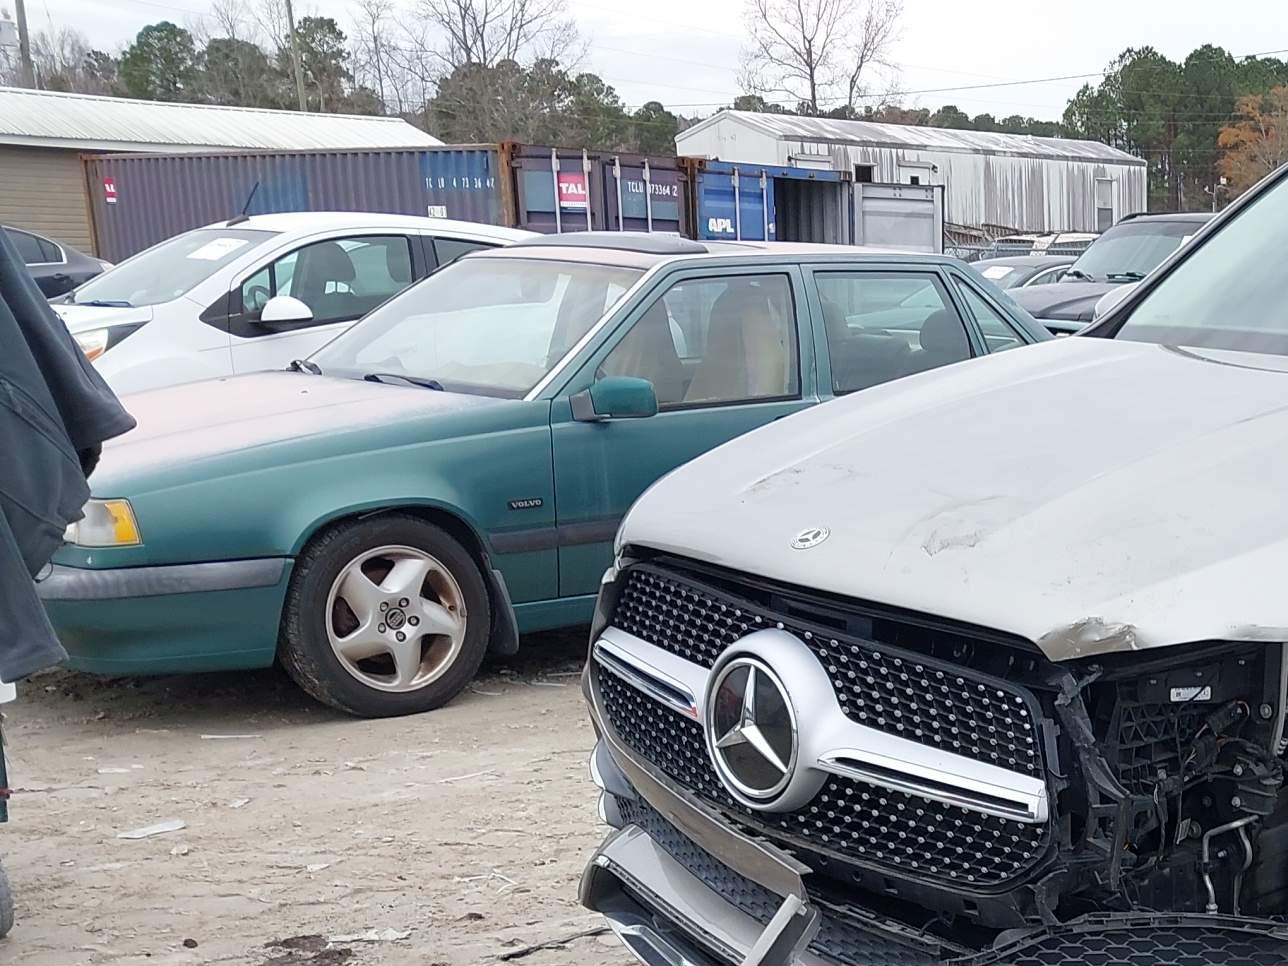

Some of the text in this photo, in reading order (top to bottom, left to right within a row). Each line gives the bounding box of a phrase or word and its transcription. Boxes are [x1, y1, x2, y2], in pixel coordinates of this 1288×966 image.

[559, 183, 586, 194] TAL
[708, 218, 735, 232] APL
[511, 499, 542, 509] VOLVO
